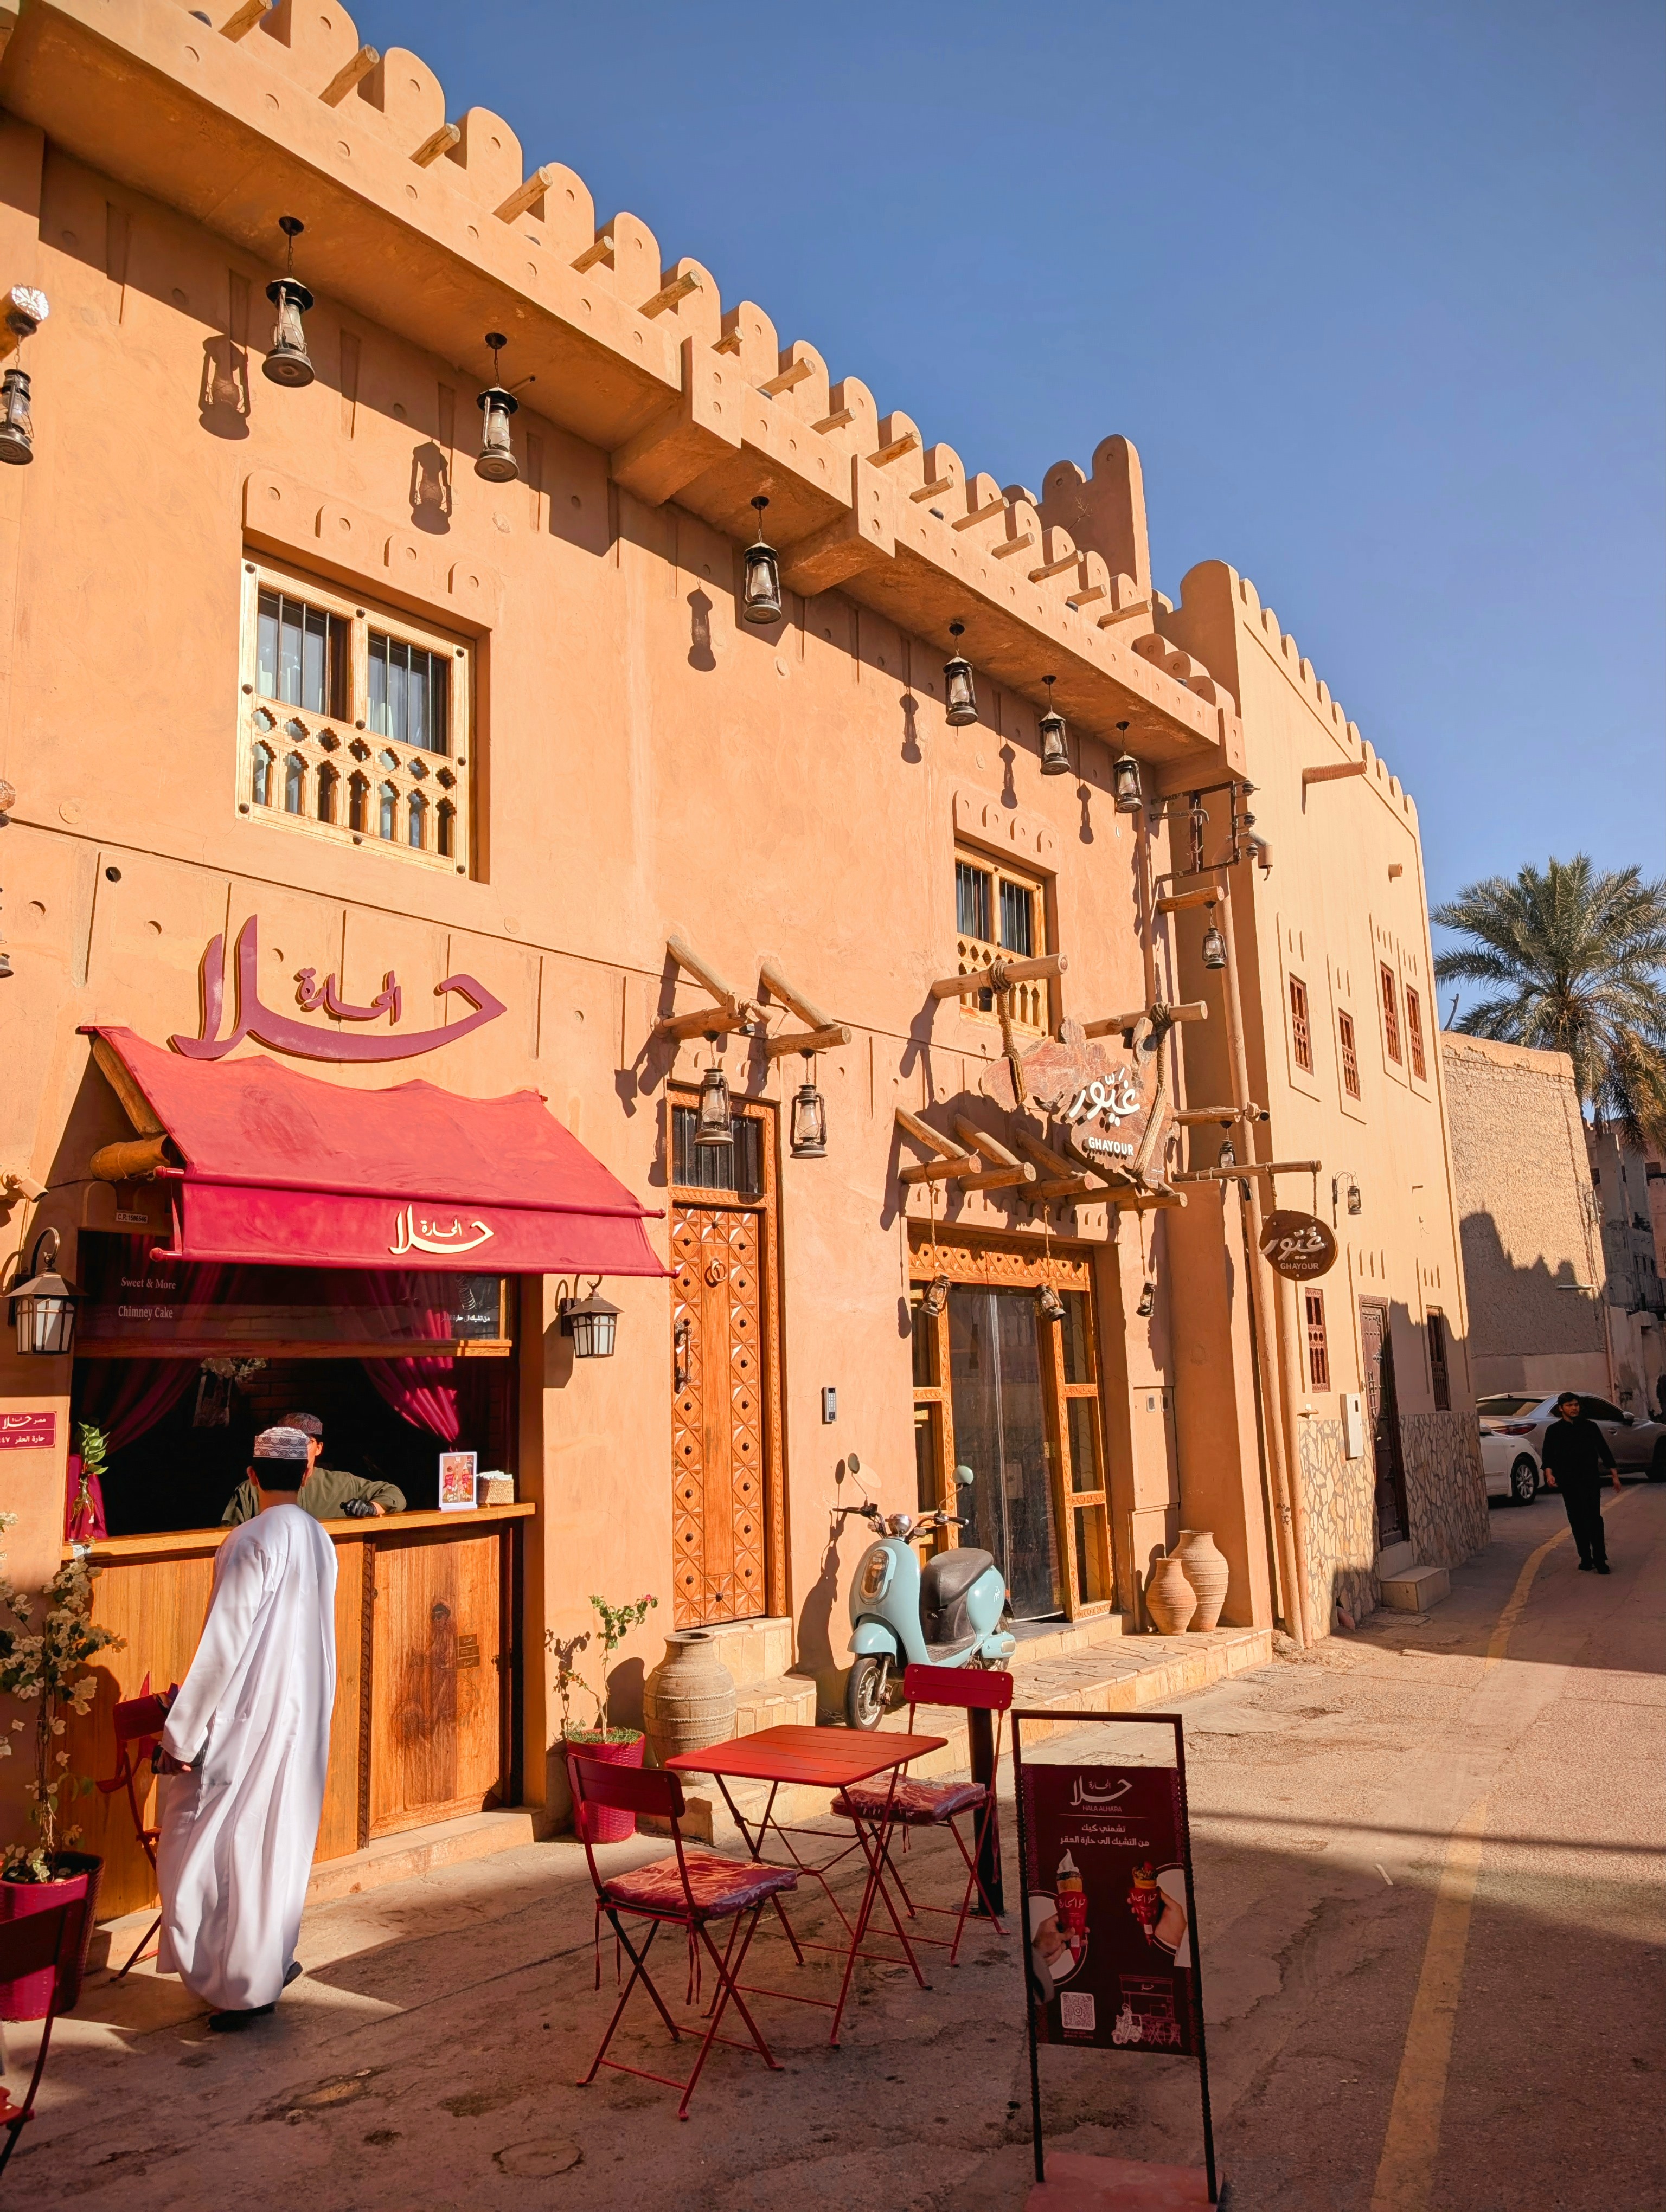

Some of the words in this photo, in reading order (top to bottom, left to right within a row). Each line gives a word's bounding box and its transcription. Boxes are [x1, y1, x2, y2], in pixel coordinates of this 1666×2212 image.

[167, 914, 508, 1061] حلا
[296, 967, 401, 1023] الحارة
[1088, 1136, 1134, 1156] GHAYOUR
[389, 1204, 495, 1255] حلا
[420, 1219, 462, 1237] الحارة
[121, 1277, 144, 1287] Sweet
[146, 1278, 153, 1288] &
[155, 1279, 176, 1289] More
[118, 1305, 152, 1321] Chimney
[155, 1307, 173, 1319] Cake
[2, 1416, 33, 1430] حلا
[15, 1436, 30, 1444] العقر
[32, 1435, 45, 1443] حارة
[1089, 1779, 1111, 1789] الحارة
[1070, 1775, 1132, 1806] حلا
[1081, 1824, 1098, 1832] كيك
[1099, 1824, 1126, 1833] تشمني
[1060, 1836, 1079, 1844] العقر
[1081, 1836, 1095, 1845] حارة
[1111, 1837, 1137, 1846] التشيك
